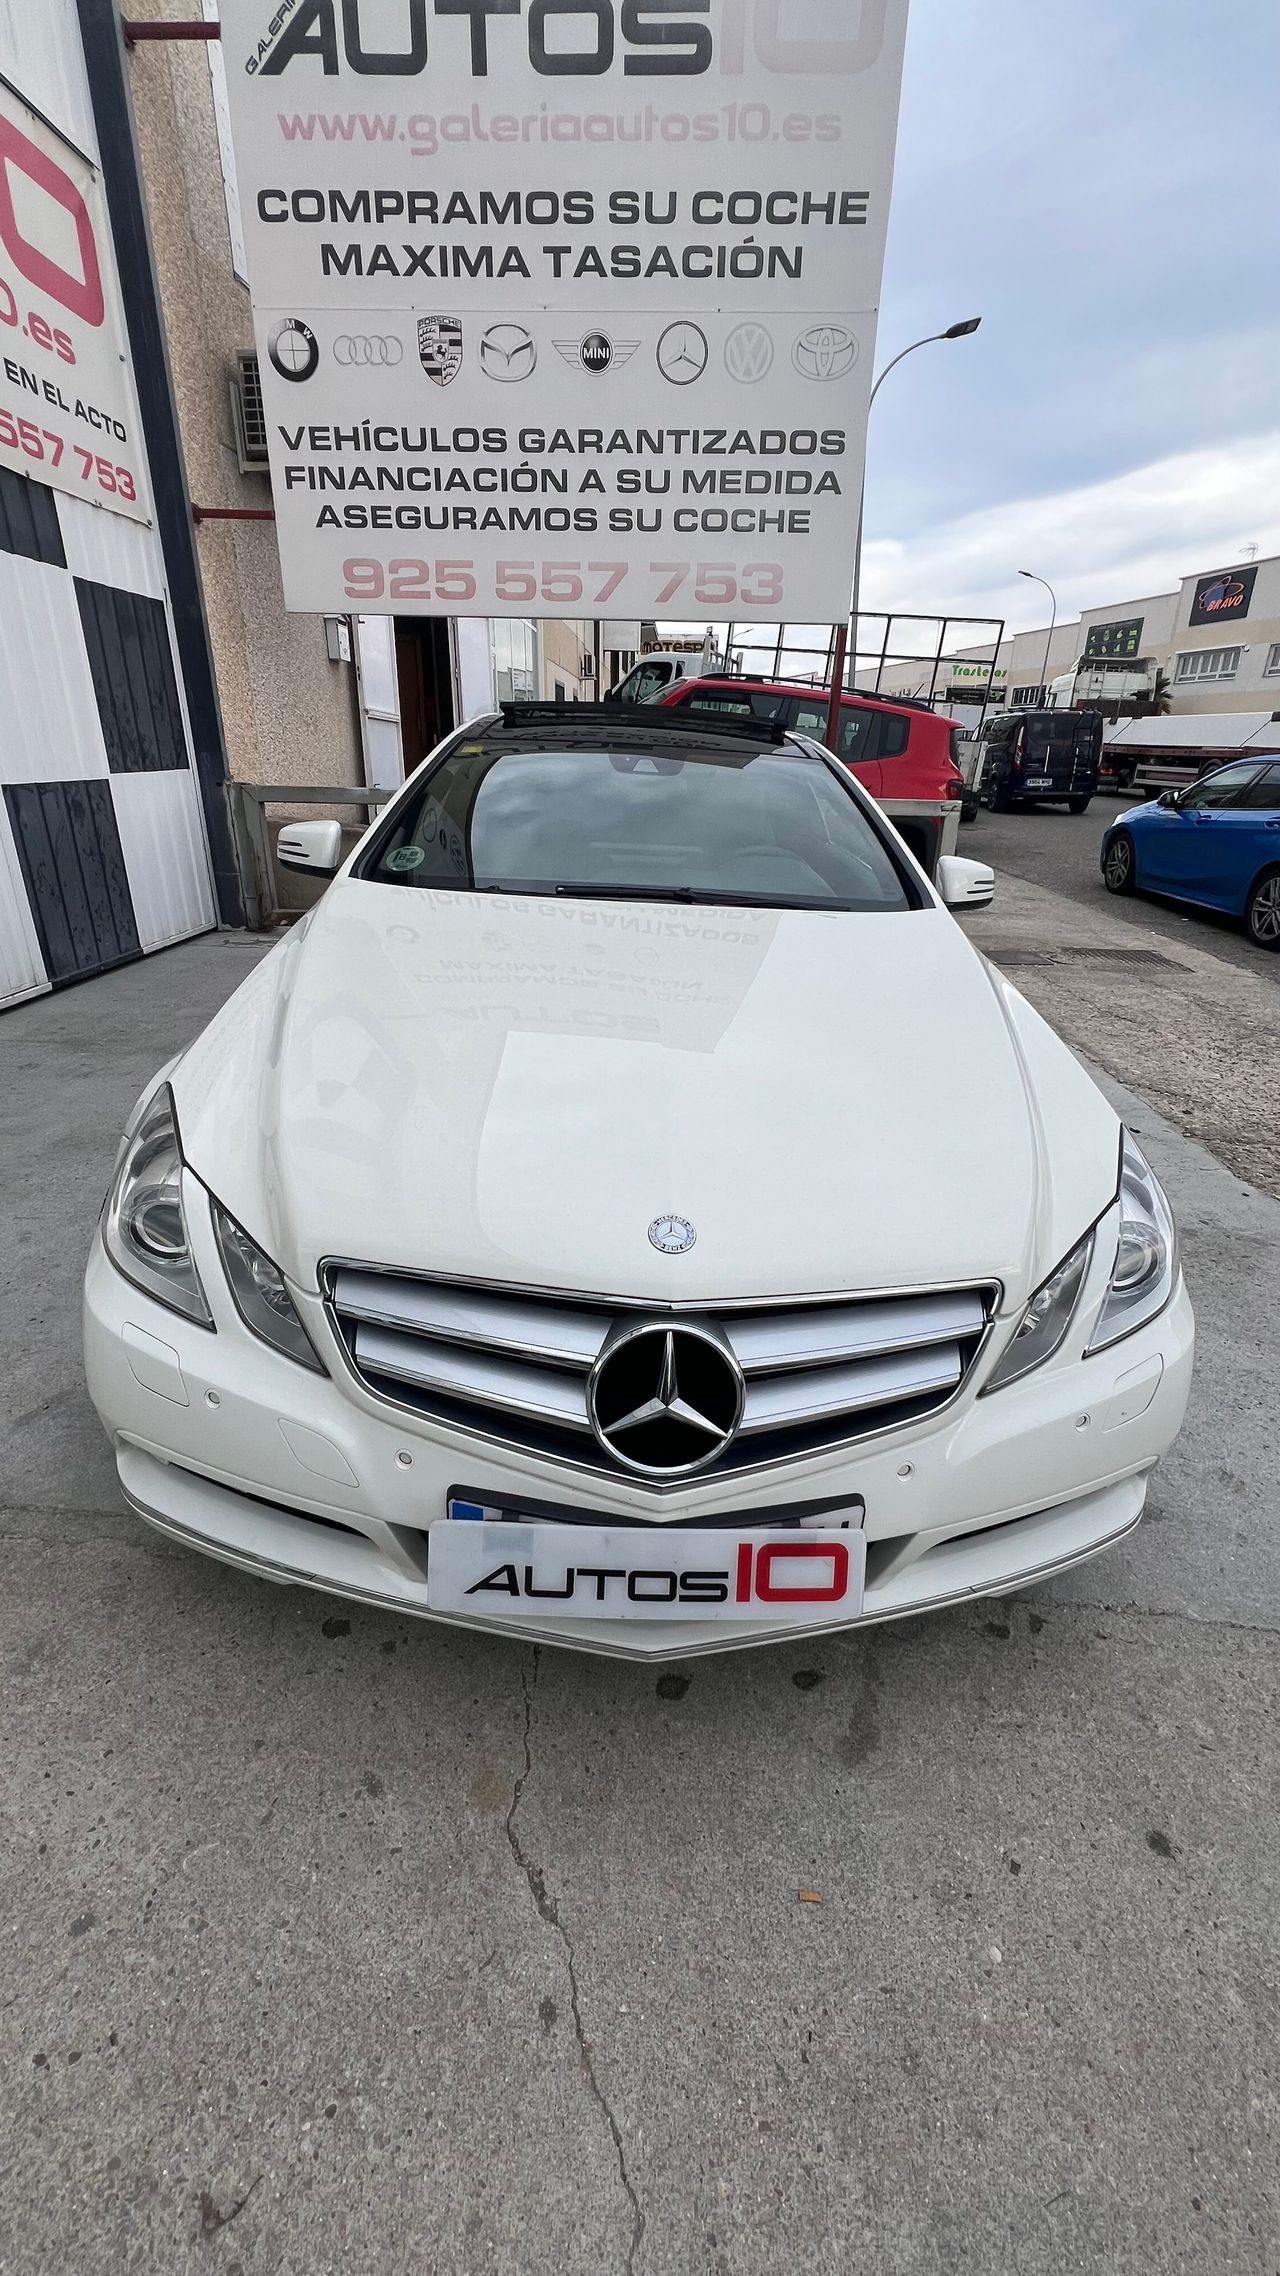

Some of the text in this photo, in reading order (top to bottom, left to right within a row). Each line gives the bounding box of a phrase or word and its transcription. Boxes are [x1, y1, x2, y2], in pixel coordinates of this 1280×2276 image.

[277, 101, 842, 156] www.galeriaautos10.es
[258, 190, 870, 225] COMPRAMOS SU COCHE
[321, 235, 803, 279] MAXIMA TASACIÓN
[583, 347, 609, 359] MINI
[4, 357, 127, 443] EN EL ACTO
[278, 419, 846, 455] VEHÍCULOS GARANTIZADOS
[73, 445, 136, 501] 753
[285, 462, 842, 495] FINANCIACIÓN A SU MEDIDA
[315, 505, 811, 534] ASEGURAMOS SU COCHE
[343, 558, 785, 604] 925 557 753
[1206, 594, 1244, 612] BRAVO
[953, 665, 1007, 677] Trasteos
[464, 1543, 849, 1602] AUTOS10
